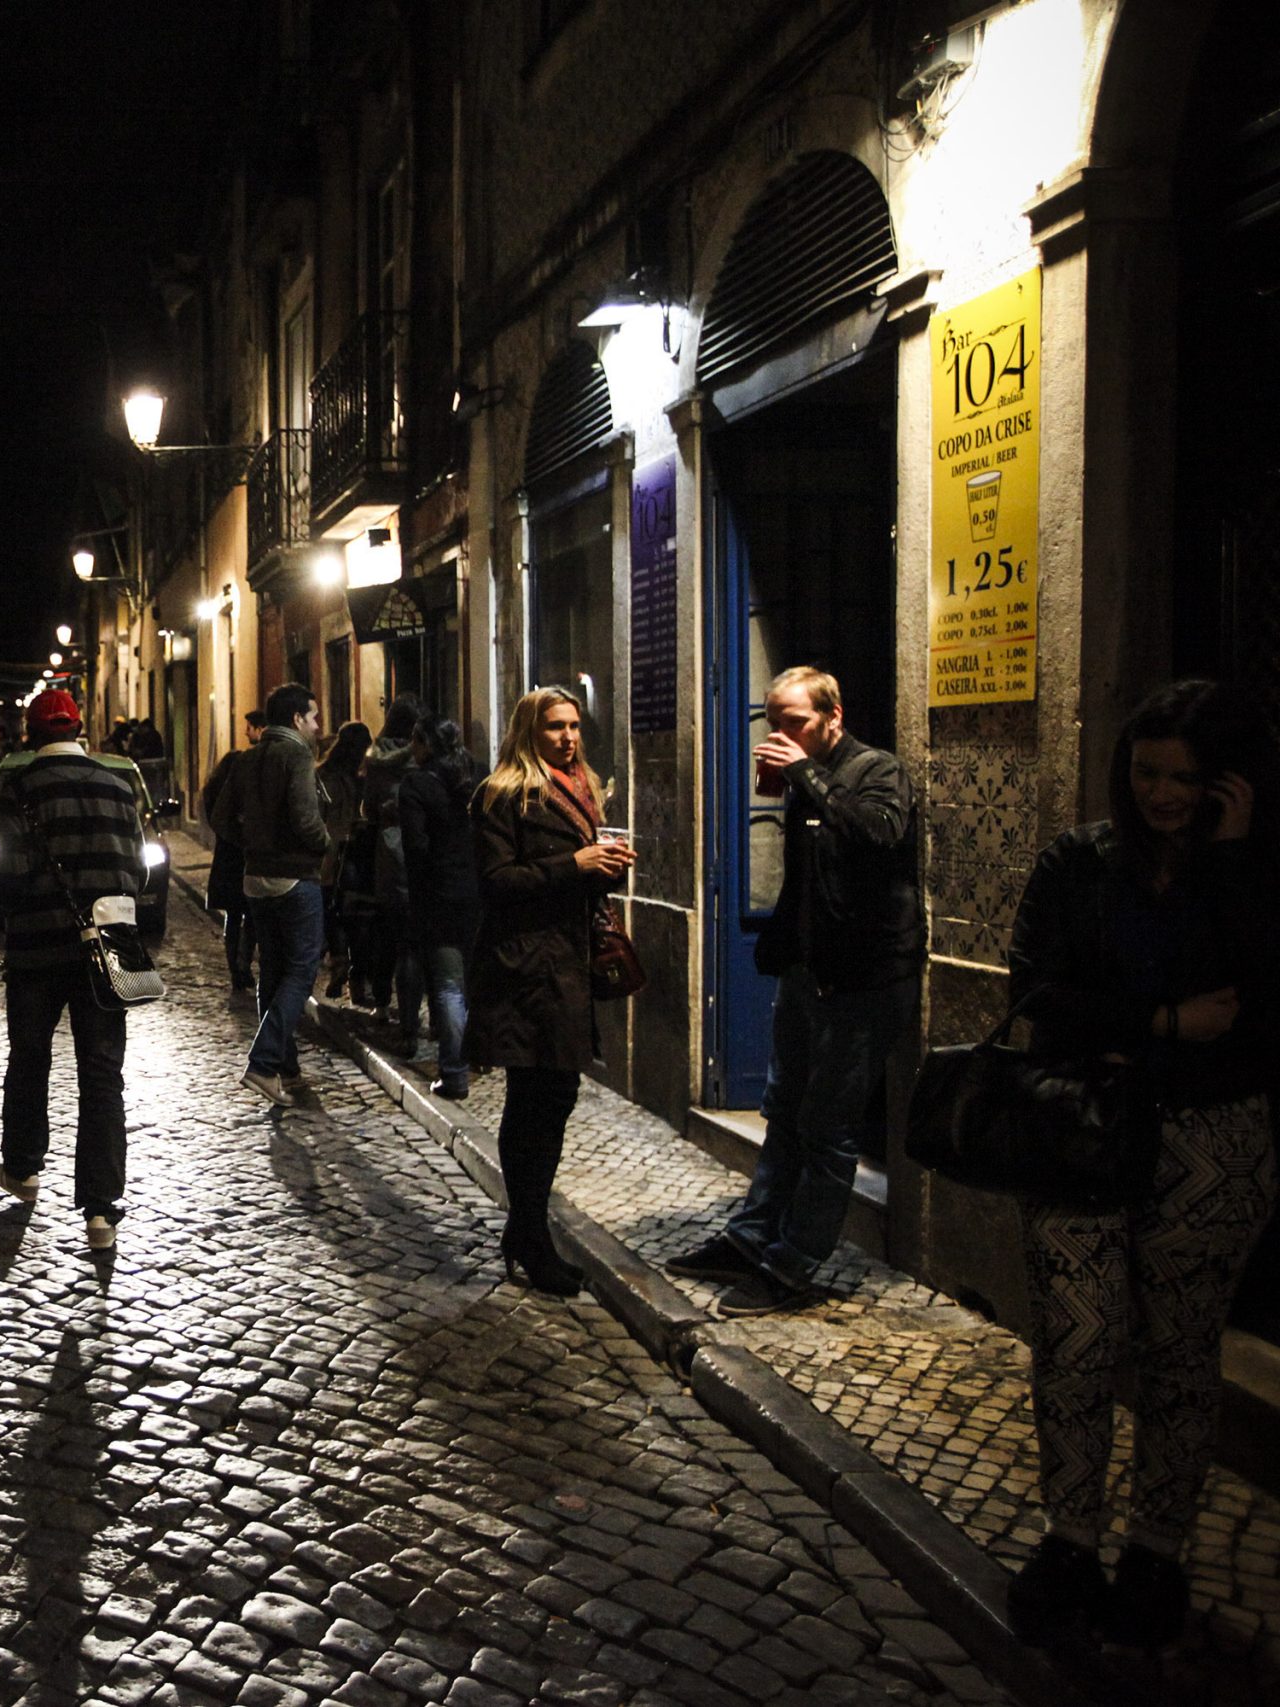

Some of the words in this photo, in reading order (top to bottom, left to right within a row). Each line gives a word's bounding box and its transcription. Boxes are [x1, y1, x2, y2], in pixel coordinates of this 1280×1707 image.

[942, 329, 972, 362] Bar
[946, 324, 1035, 416] 104
[938, 432, 972, 461] COPO
[975, 425, 993, 449] DA
[995, 410, 1032, 442] CRISE
[951, 455, 990, 478] IMPERIAL
[996, 447, 1018, 464] BEER
[946, 545, 1028, 601] 1,25€
[937, 612, 964, 625] COPO
[937, 629, 964, 642] COPO
[936, 654, 980, 675] SANGRIA
[987, 650, 993, 661] L
[937, 677, 978, 697] CASEIRA
[984, 666, 995, 678] XL
[981, 682, 997, 693] XXL
